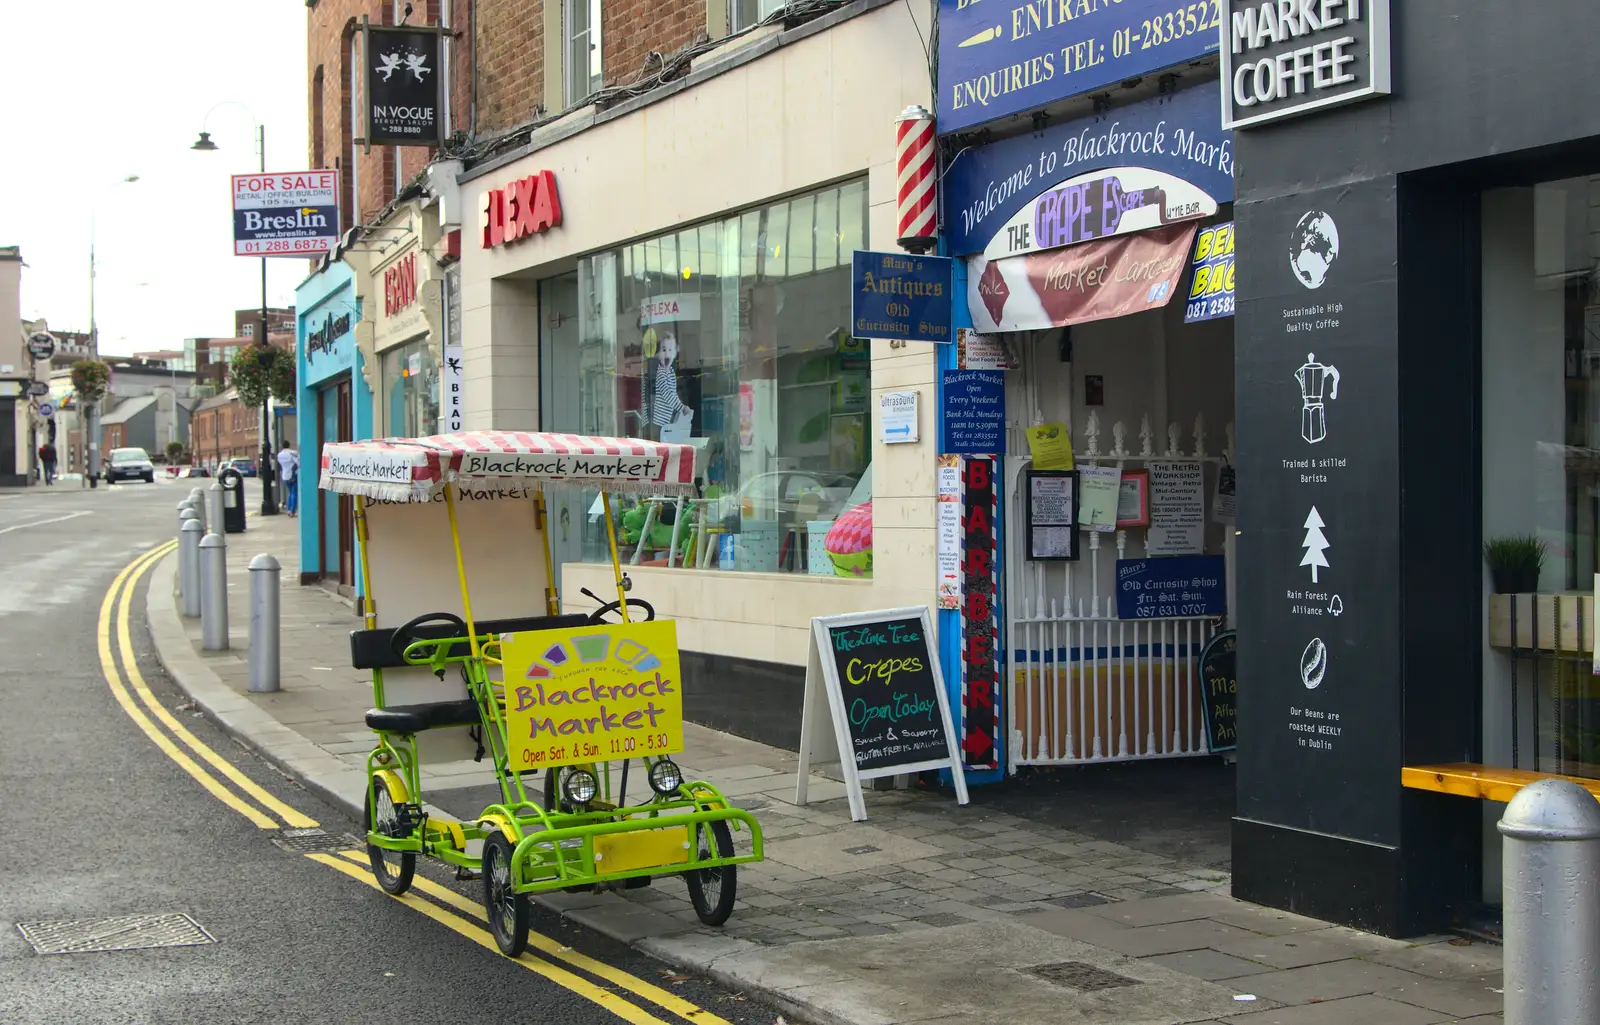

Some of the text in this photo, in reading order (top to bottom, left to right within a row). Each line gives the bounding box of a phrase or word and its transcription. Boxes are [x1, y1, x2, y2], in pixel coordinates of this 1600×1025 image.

[952, 1, 1220, 110] ENQUIRIES TEL: 01-2833522
[1233, 36, 1354, 106] COFFEE
[373, 105, 434, 120] IN VOGUE
[237, 175, 332, 192] FOR SALE
[961, 163, 1033, 237] Welcome
[1039, 151, 1057, 178] to
[1064, 121, 1166, 168] Blackrock
[267, 190, 294, 198] OFFICE
[295, 189, 332, 197] BUILDING
[479, 169, 561, 250] FLEXA
[1007, 223, 1031, 252] THE
[1035, 181, 1093, 248] GRAPE
[1186, 202, 1200, 216] BAR
[243, 208, 327, 231] Breslin
[254, 229, 317, 238] www.breslin.ie
[245, 239, 328, 252] 01 288 6875
[882, 256, 923, 272] Mary's
[1044, 256, 1109, 293] Market
[1115, 253, 1182, 284] Canteen
[861, 271, 943, 300] Antiques
[886, 302, 910, 317] Old
[1186, 301, 1208, 319] 087
[1283, 303, 1343, 318] Sustainable High
[857, 318, 947, 336] Curiosity Shop
[1286, 319, 1340, 333] Quality Coffee
[944, 371, 1003, 385] Blackrock Market
[966, 385, 982, 395] Open
[881, 395, 915, 407] ultrasound
[948, 395, 999, 406] Every Weekend
[945, 410, 962, 418] Bank
[976, 410, 1003, 420] Mondays
[331, 457, 408, 480] Blackrock Market
[466, 457, 656, 476] Blackrock Market
[1282, 458, 1347, 469] Trained & skilled
[1300, 474, 1328, 483] Barista
[1119, 562, 1146, 578] Mary's
[967, 461, 992, 709] BARBER
[1122, 577, 1218, 591] Old Curiosity Shop
[1136, 591, 1205, 605] Fri. Sat. Sun.
[1286, 590, 1328, 600] Rain Forest
[1136, 604, 1207, 617] 087 631 0707
[1292, 605, 1323, 616] Alliance
[854, 628, 887, 646] Lime
[888, 624, 920, 644] Tree
[846, 656, 924, 686] Crepes
[514, 672, 675, 712] Blackrock
[851, 692, 936, 733] Open Today
[1290, 706, 1340, 721] Our Beans are
[529, 702, 665, 739] Market
[886, 727, 899, 741] &
[1289, 722, 1342, 737] roasted WEEKLY
[523, 748, 546, 766] Open
[550, 746, 569, 761] Sat.
[573, 743, 580, 758] &
[583, 743, 602, 758] Sun.
[610, 736, 636, 754] 11.00
[647, 733, 668, 750] 5.30
[1298, 737, 1332, 750] in Dublin
